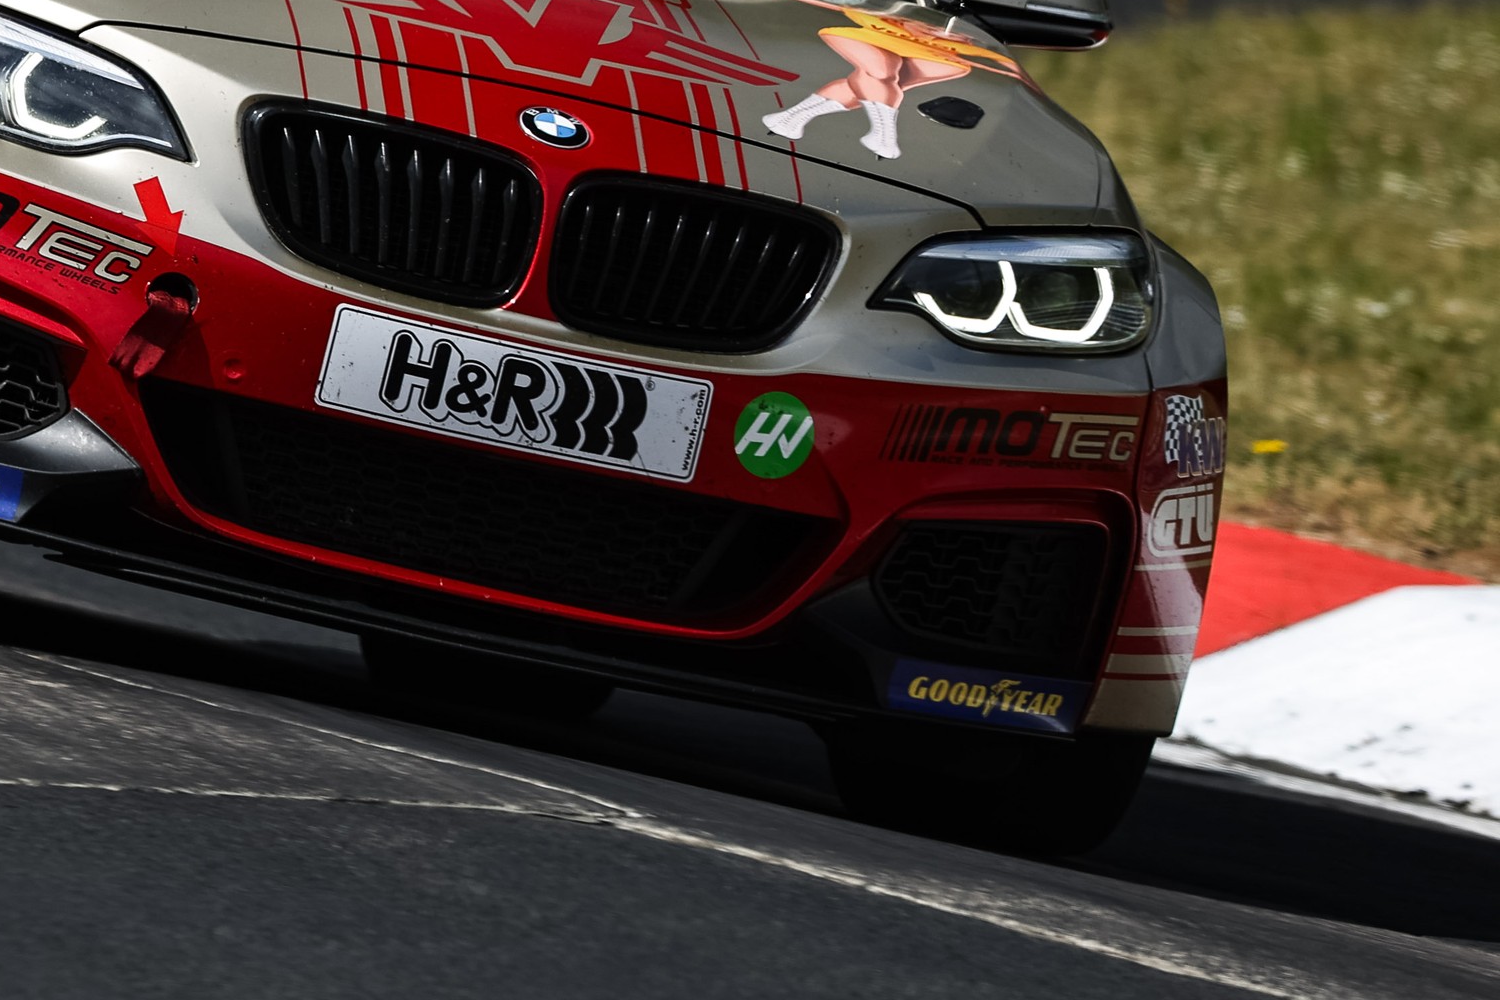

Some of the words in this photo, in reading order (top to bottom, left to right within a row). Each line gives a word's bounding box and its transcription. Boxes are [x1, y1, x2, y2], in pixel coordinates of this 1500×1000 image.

[60, 266, 122, 297] WHEELS
[380, 330, 556, 443] H&R
[681, 388, 707, 472] www.h-r.com
[1176, 416, 1226, 479] KW
